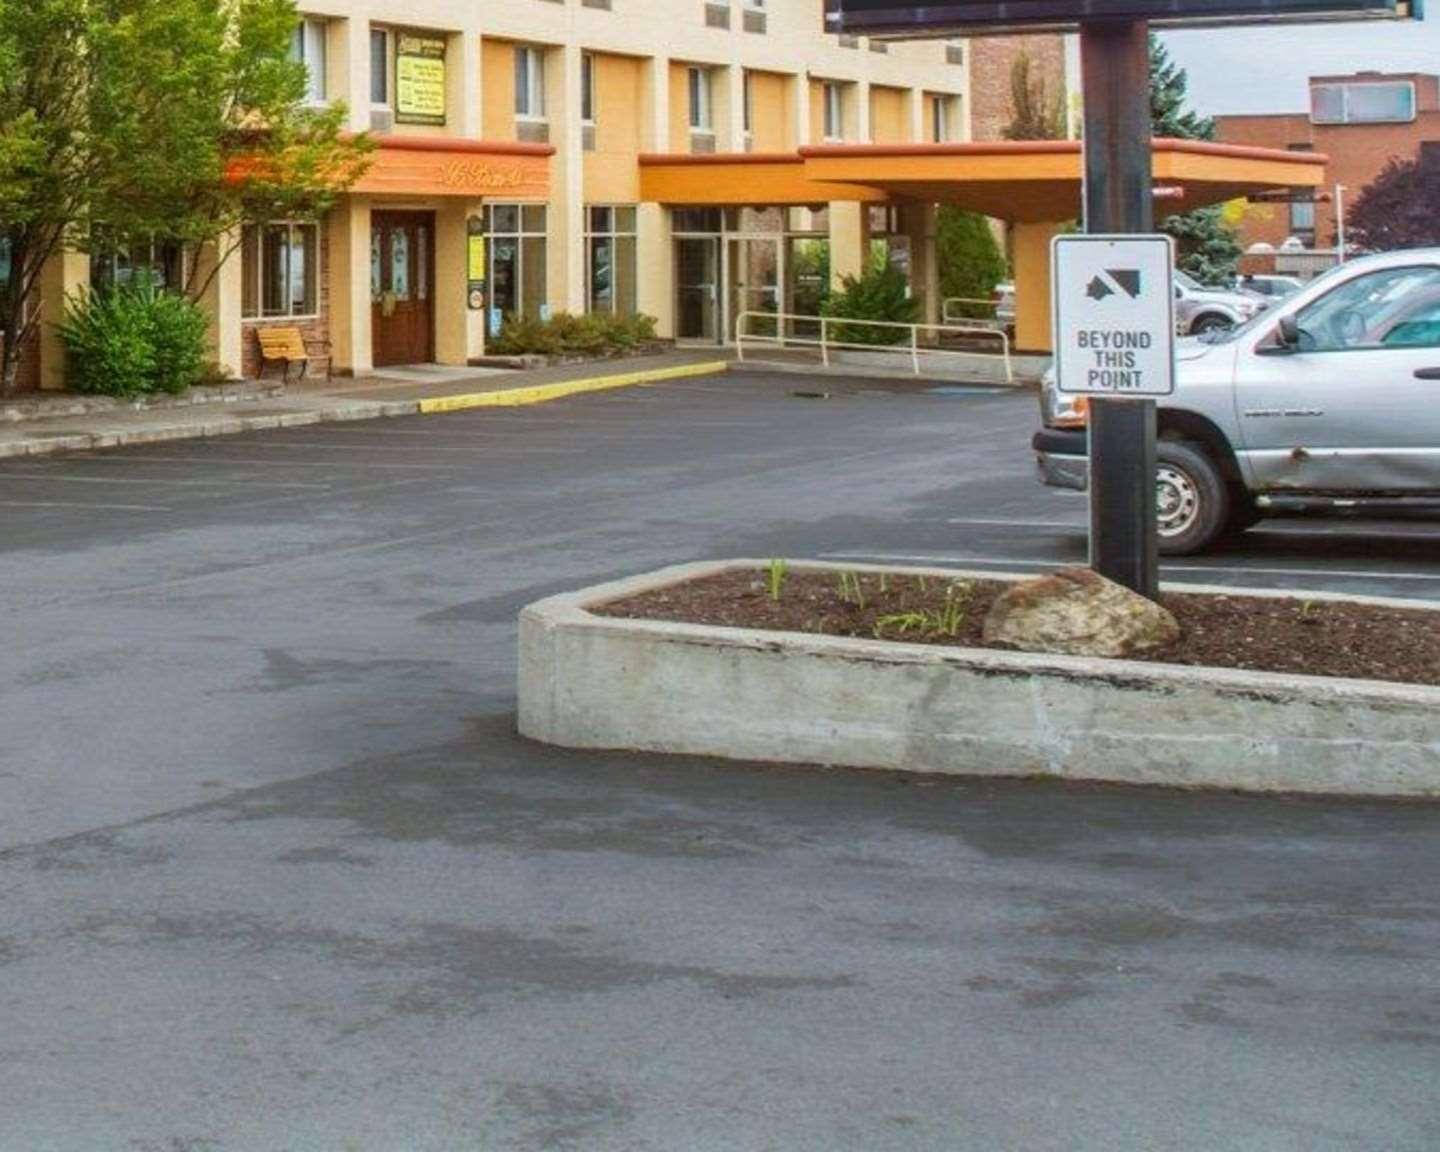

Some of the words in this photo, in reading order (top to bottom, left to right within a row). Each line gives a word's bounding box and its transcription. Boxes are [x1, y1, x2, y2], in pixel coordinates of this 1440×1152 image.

[1077, 330, 1152, 349] BEYOND
[1094, 350, 1136, 368] THIS
[1087, 369, 1143, 389] POINT
